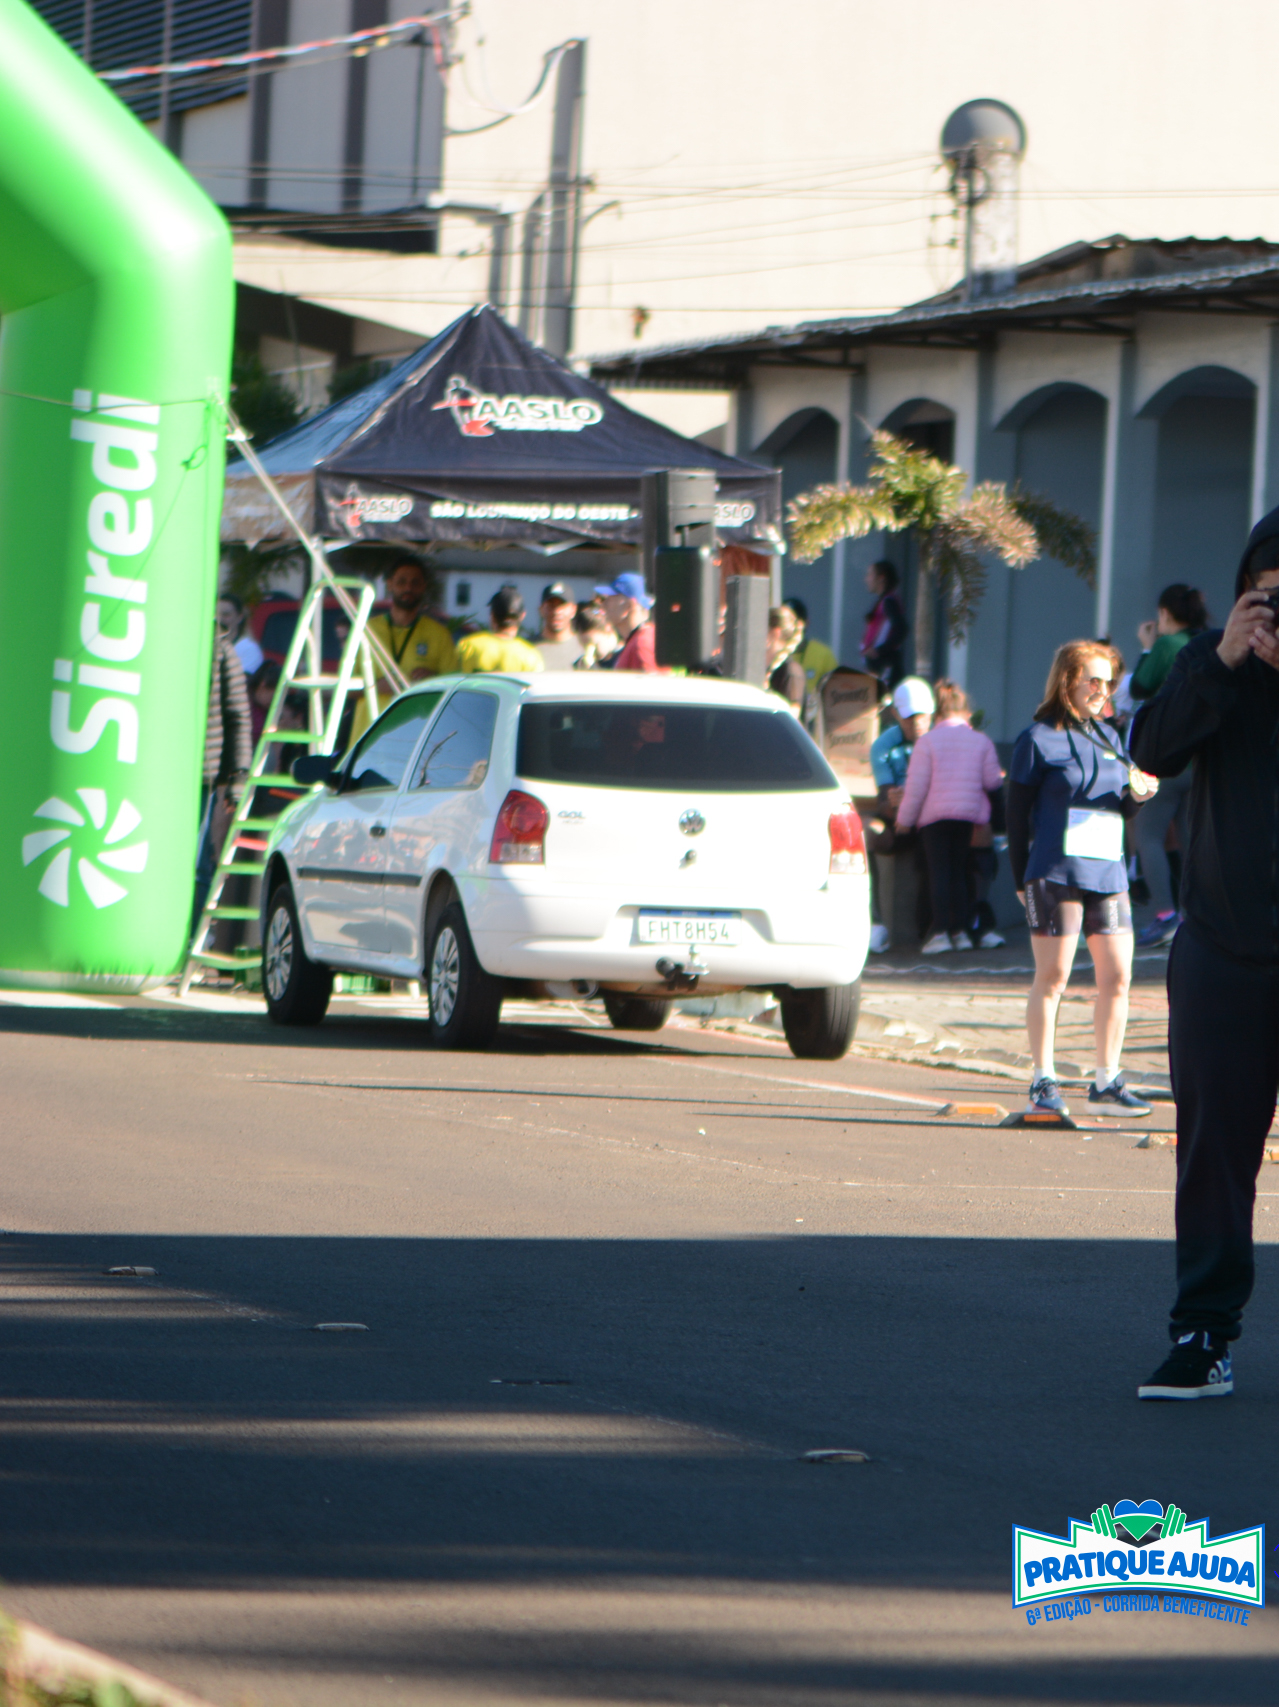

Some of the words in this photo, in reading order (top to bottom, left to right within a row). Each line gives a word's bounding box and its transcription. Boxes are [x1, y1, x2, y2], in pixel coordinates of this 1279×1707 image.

[473, 396, 602, 424] AASLO
[355, 496, 414, 516] AASLO
[430, 501, 465, 518] SÃO
[552, 505, 576, 520] DO
[577, 505, 630, 521] OESTE
[714, 502, 755, 521] SLO
[50, 389, 160, 764] Sicredi
[648, 920, 729, 940] FHT8H54
